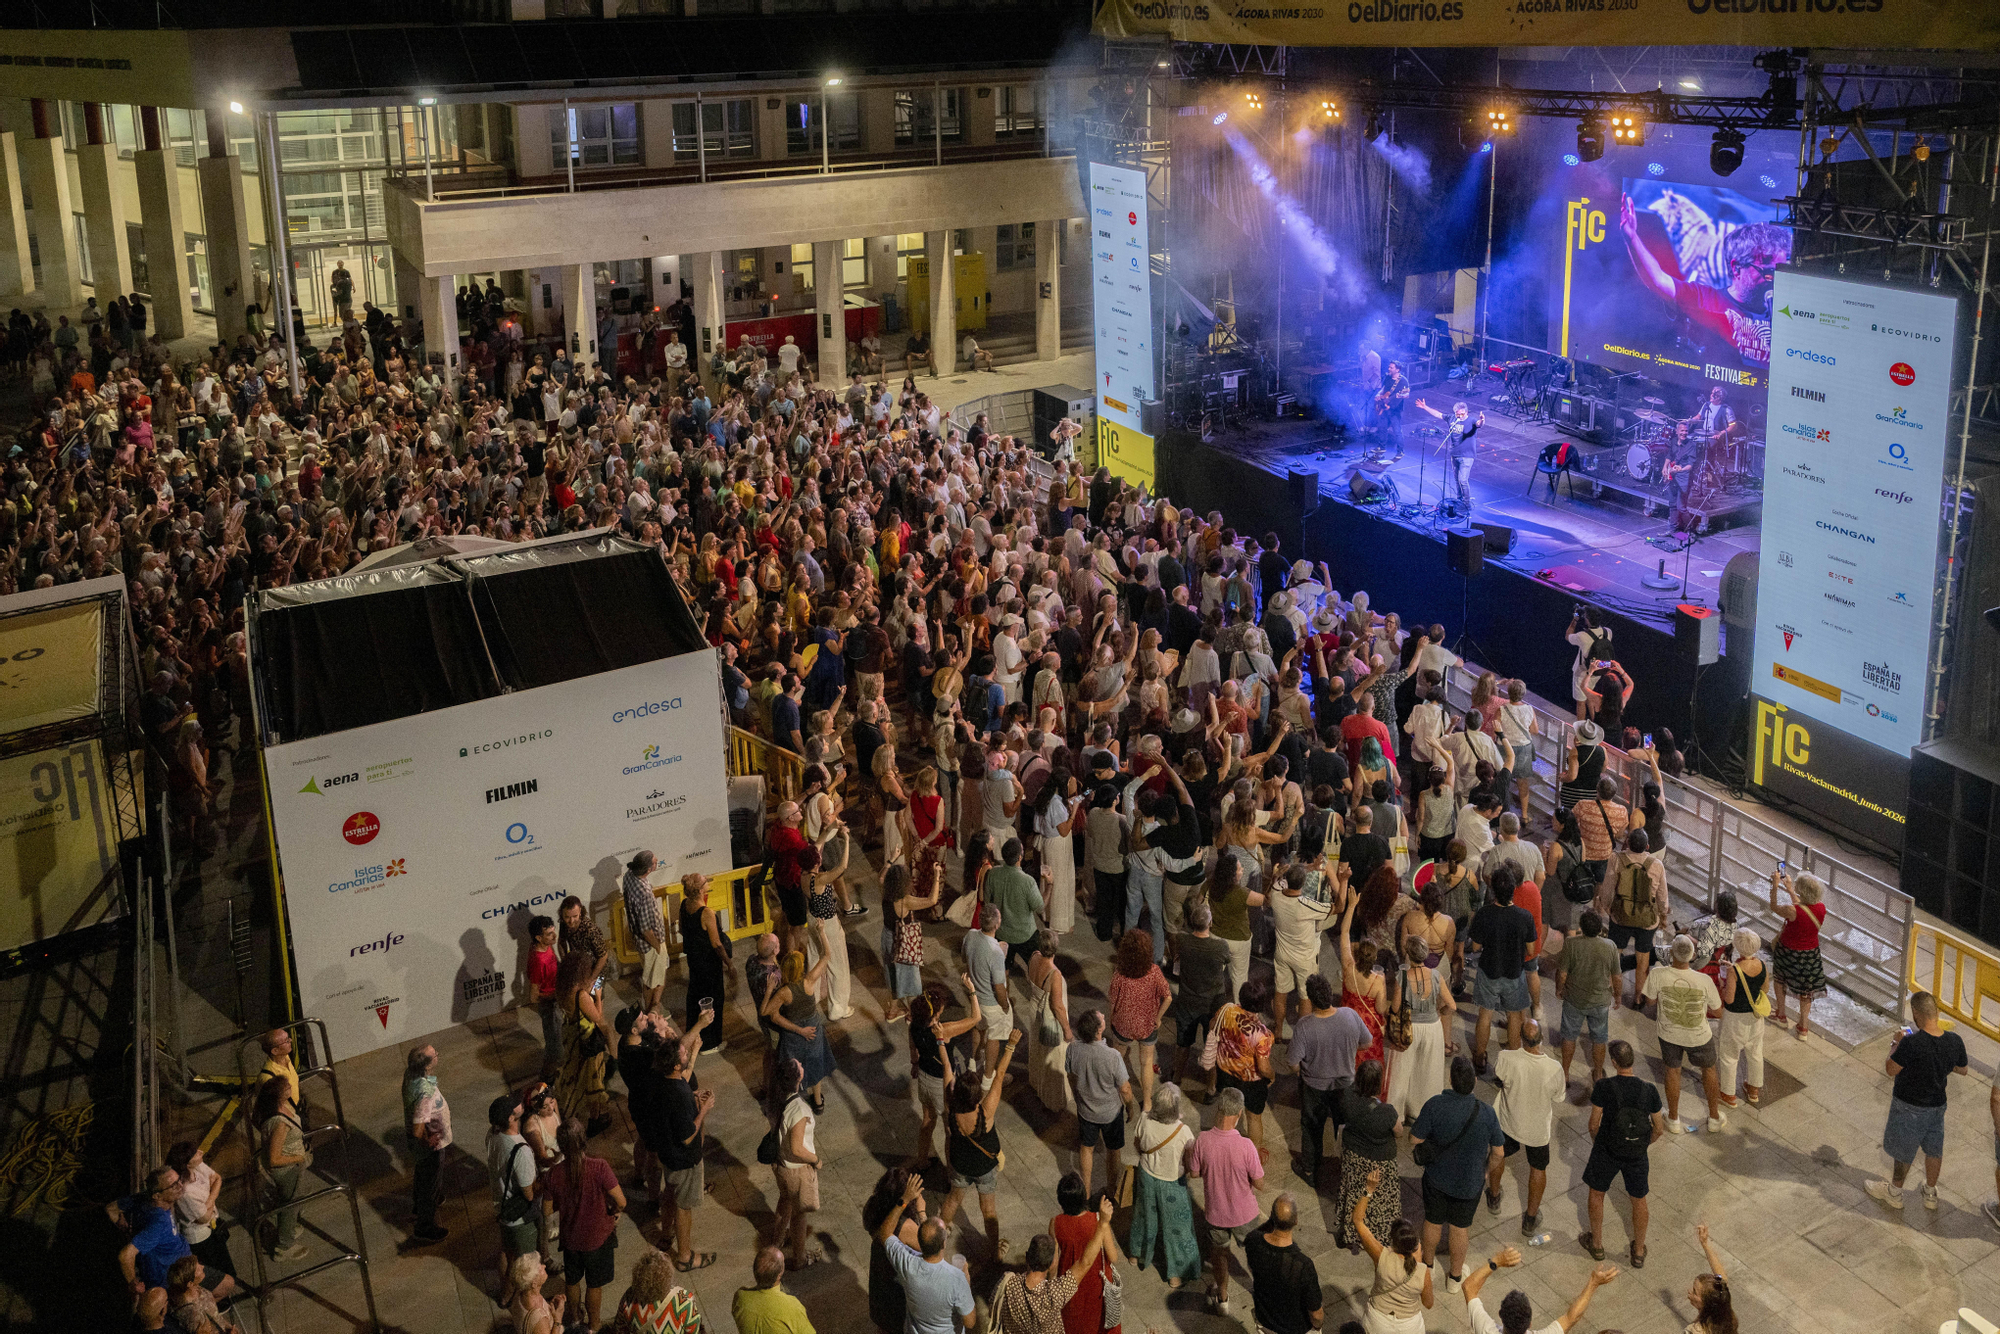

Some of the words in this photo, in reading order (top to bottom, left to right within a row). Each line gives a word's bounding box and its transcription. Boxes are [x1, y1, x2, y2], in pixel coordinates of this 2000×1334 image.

[1272, 8, 1300, 19] RIVAS
[1302, 8, 1324, 19] 2030
[1793, 309, 1816, 319] aena
[1881, 326, 1941, 343] ECOVIDRIO
[1786, 348, 1836, 366] endesa
[1791, 386, 1826, 403] FILMIN
[1798, 422, 1817, 433] Islas
[1875, 413, 1924, 430] GranCanaria
[1782, 424, 1816, 439] Canarias
[1782, 466, 1826, 484] PARADORES
[1874, 488, 1913, 504] renfe
[1815, 520, 1876, 544] CHANGAN
[1891, 671, 1902, 682] EN
[612, 697, 683, 723] endesa
[473, 729, 553, 755] ECOVIDRIO
[365, 757, 413, 773] aeropuertos
[622, 755, 682, 776] GranCanaria
[323, 771, 360, 788] aena
[366, 772, 385, 784] para
[485, 778, 538, 804] FILMIN
[626, 794, 687, 819] PARADORES
[1882, 807, 1906, 825] 2026
[345, 824, 379, 838] ESTRELLA
[354, 864, 384, 878] Islas
[328, 873, 385, 893] Canarias
[481, 889, 567, 920] CHANGAN
[350, 930, 405, 958] renfe
[494, 971, 505, 981] EN
[464, 980, 506, 1000] LIBERTAD
